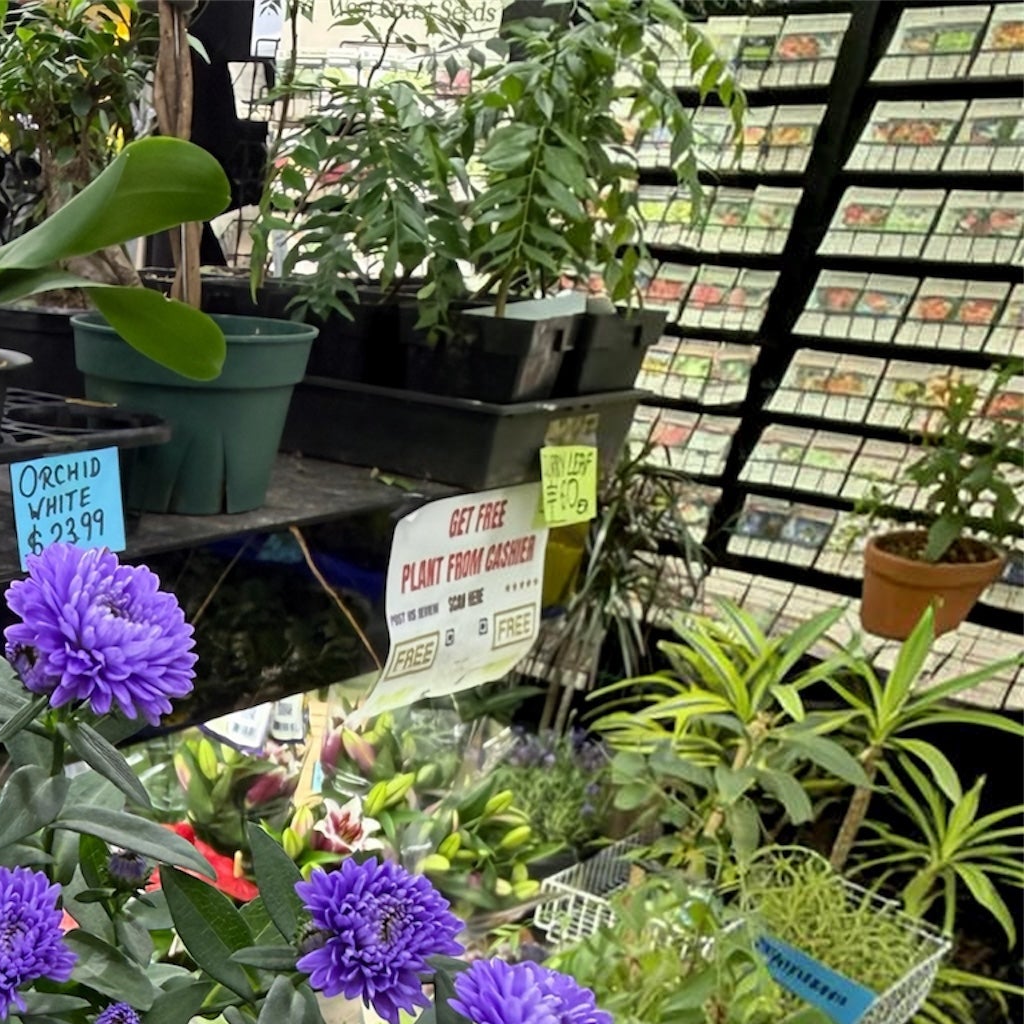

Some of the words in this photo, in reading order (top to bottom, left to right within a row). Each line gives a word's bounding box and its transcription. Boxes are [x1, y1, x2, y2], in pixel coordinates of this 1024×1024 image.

[19, 457, 100, 498] ORCHID
[28, 486, 90, 520] WHITE
[449, 506, 475, 537] GET
[476, 499, 508, 532] FREE
[401, 556, 444, 594] PLANT
[446, 547, 484, 583] FROM
[485, 535, 536, 572] CASHIER
[497, 612, 532, 643] FREE
[392, 641, 434, 674] FREE
